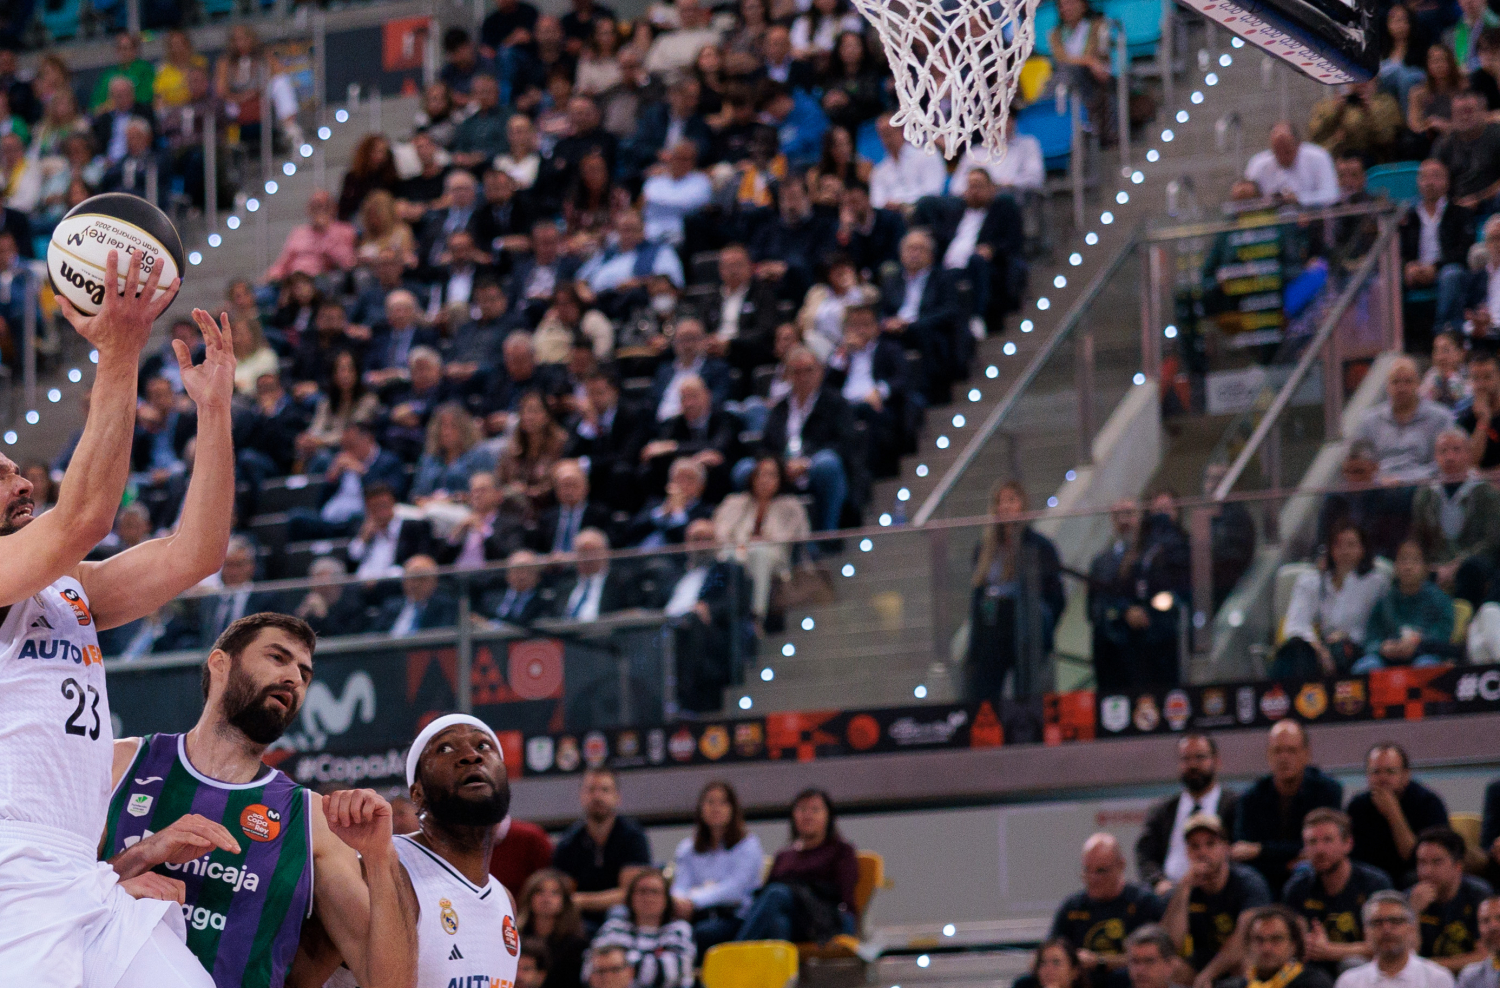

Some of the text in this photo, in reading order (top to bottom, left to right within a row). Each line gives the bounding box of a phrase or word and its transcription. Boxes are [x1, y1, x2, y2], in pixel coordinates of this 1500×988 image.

[84, 225, 155, 267] opa del Rey
[94, 220, 159, 255] Gran Canaria 2025
[61, 677, 100, 741] 23
[247, 814, 268, 827] Copa
[254, 824, 269, 834] Rey
